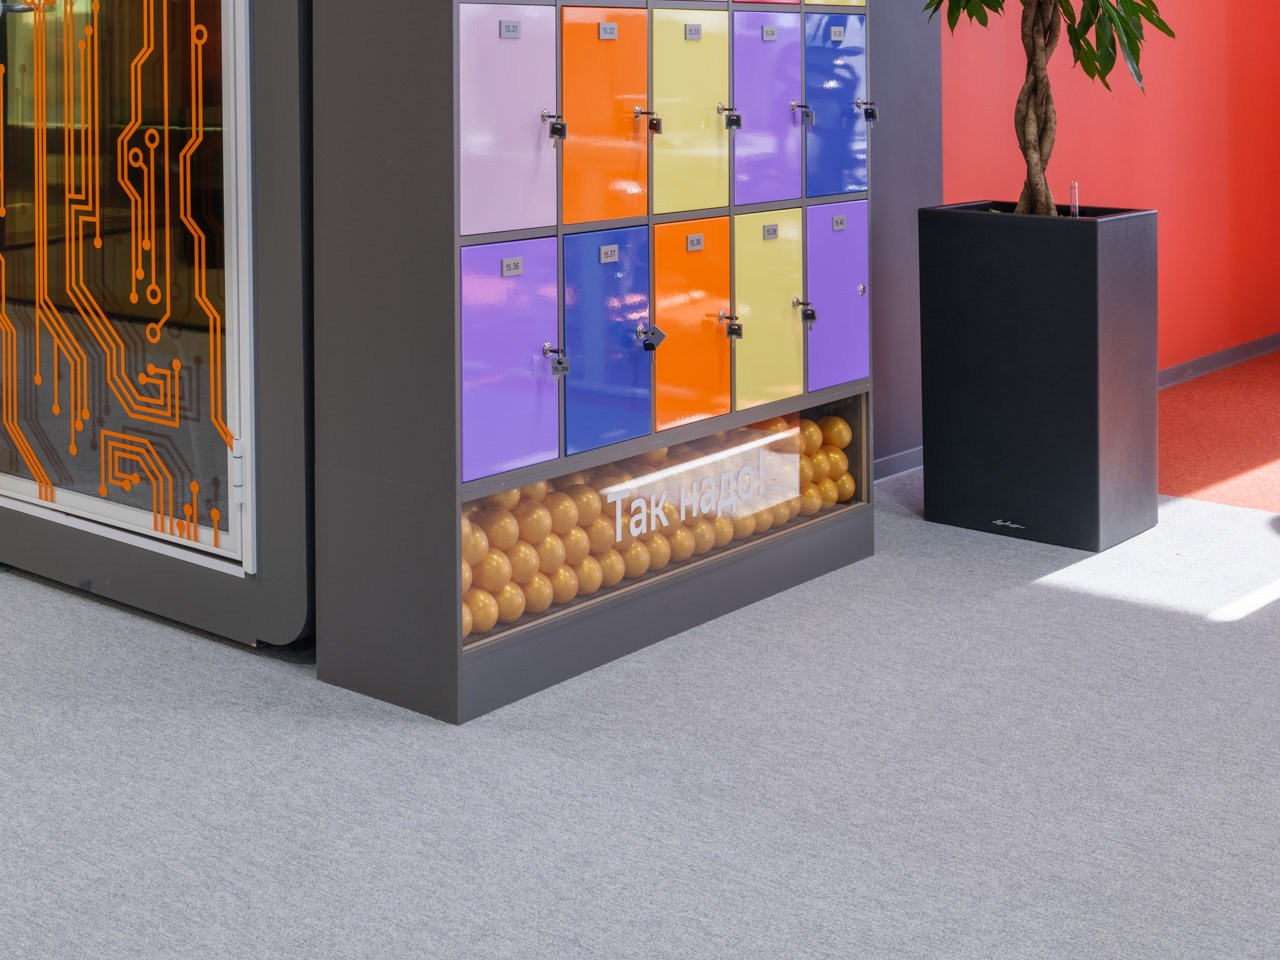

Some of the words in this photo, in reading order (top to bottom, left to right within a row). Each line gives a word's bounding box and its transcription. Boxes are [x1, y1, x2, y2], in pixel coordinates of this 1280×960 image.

[504, 25, 518, 33] 15.31
[603, 27, 615, 35] 15.32
[603, 249, 616, 259] 15.37
[505, 262, 520, 272] 15.36
[607, 488, 669, 542] Так
[680, 448, 766, 521] надо!
